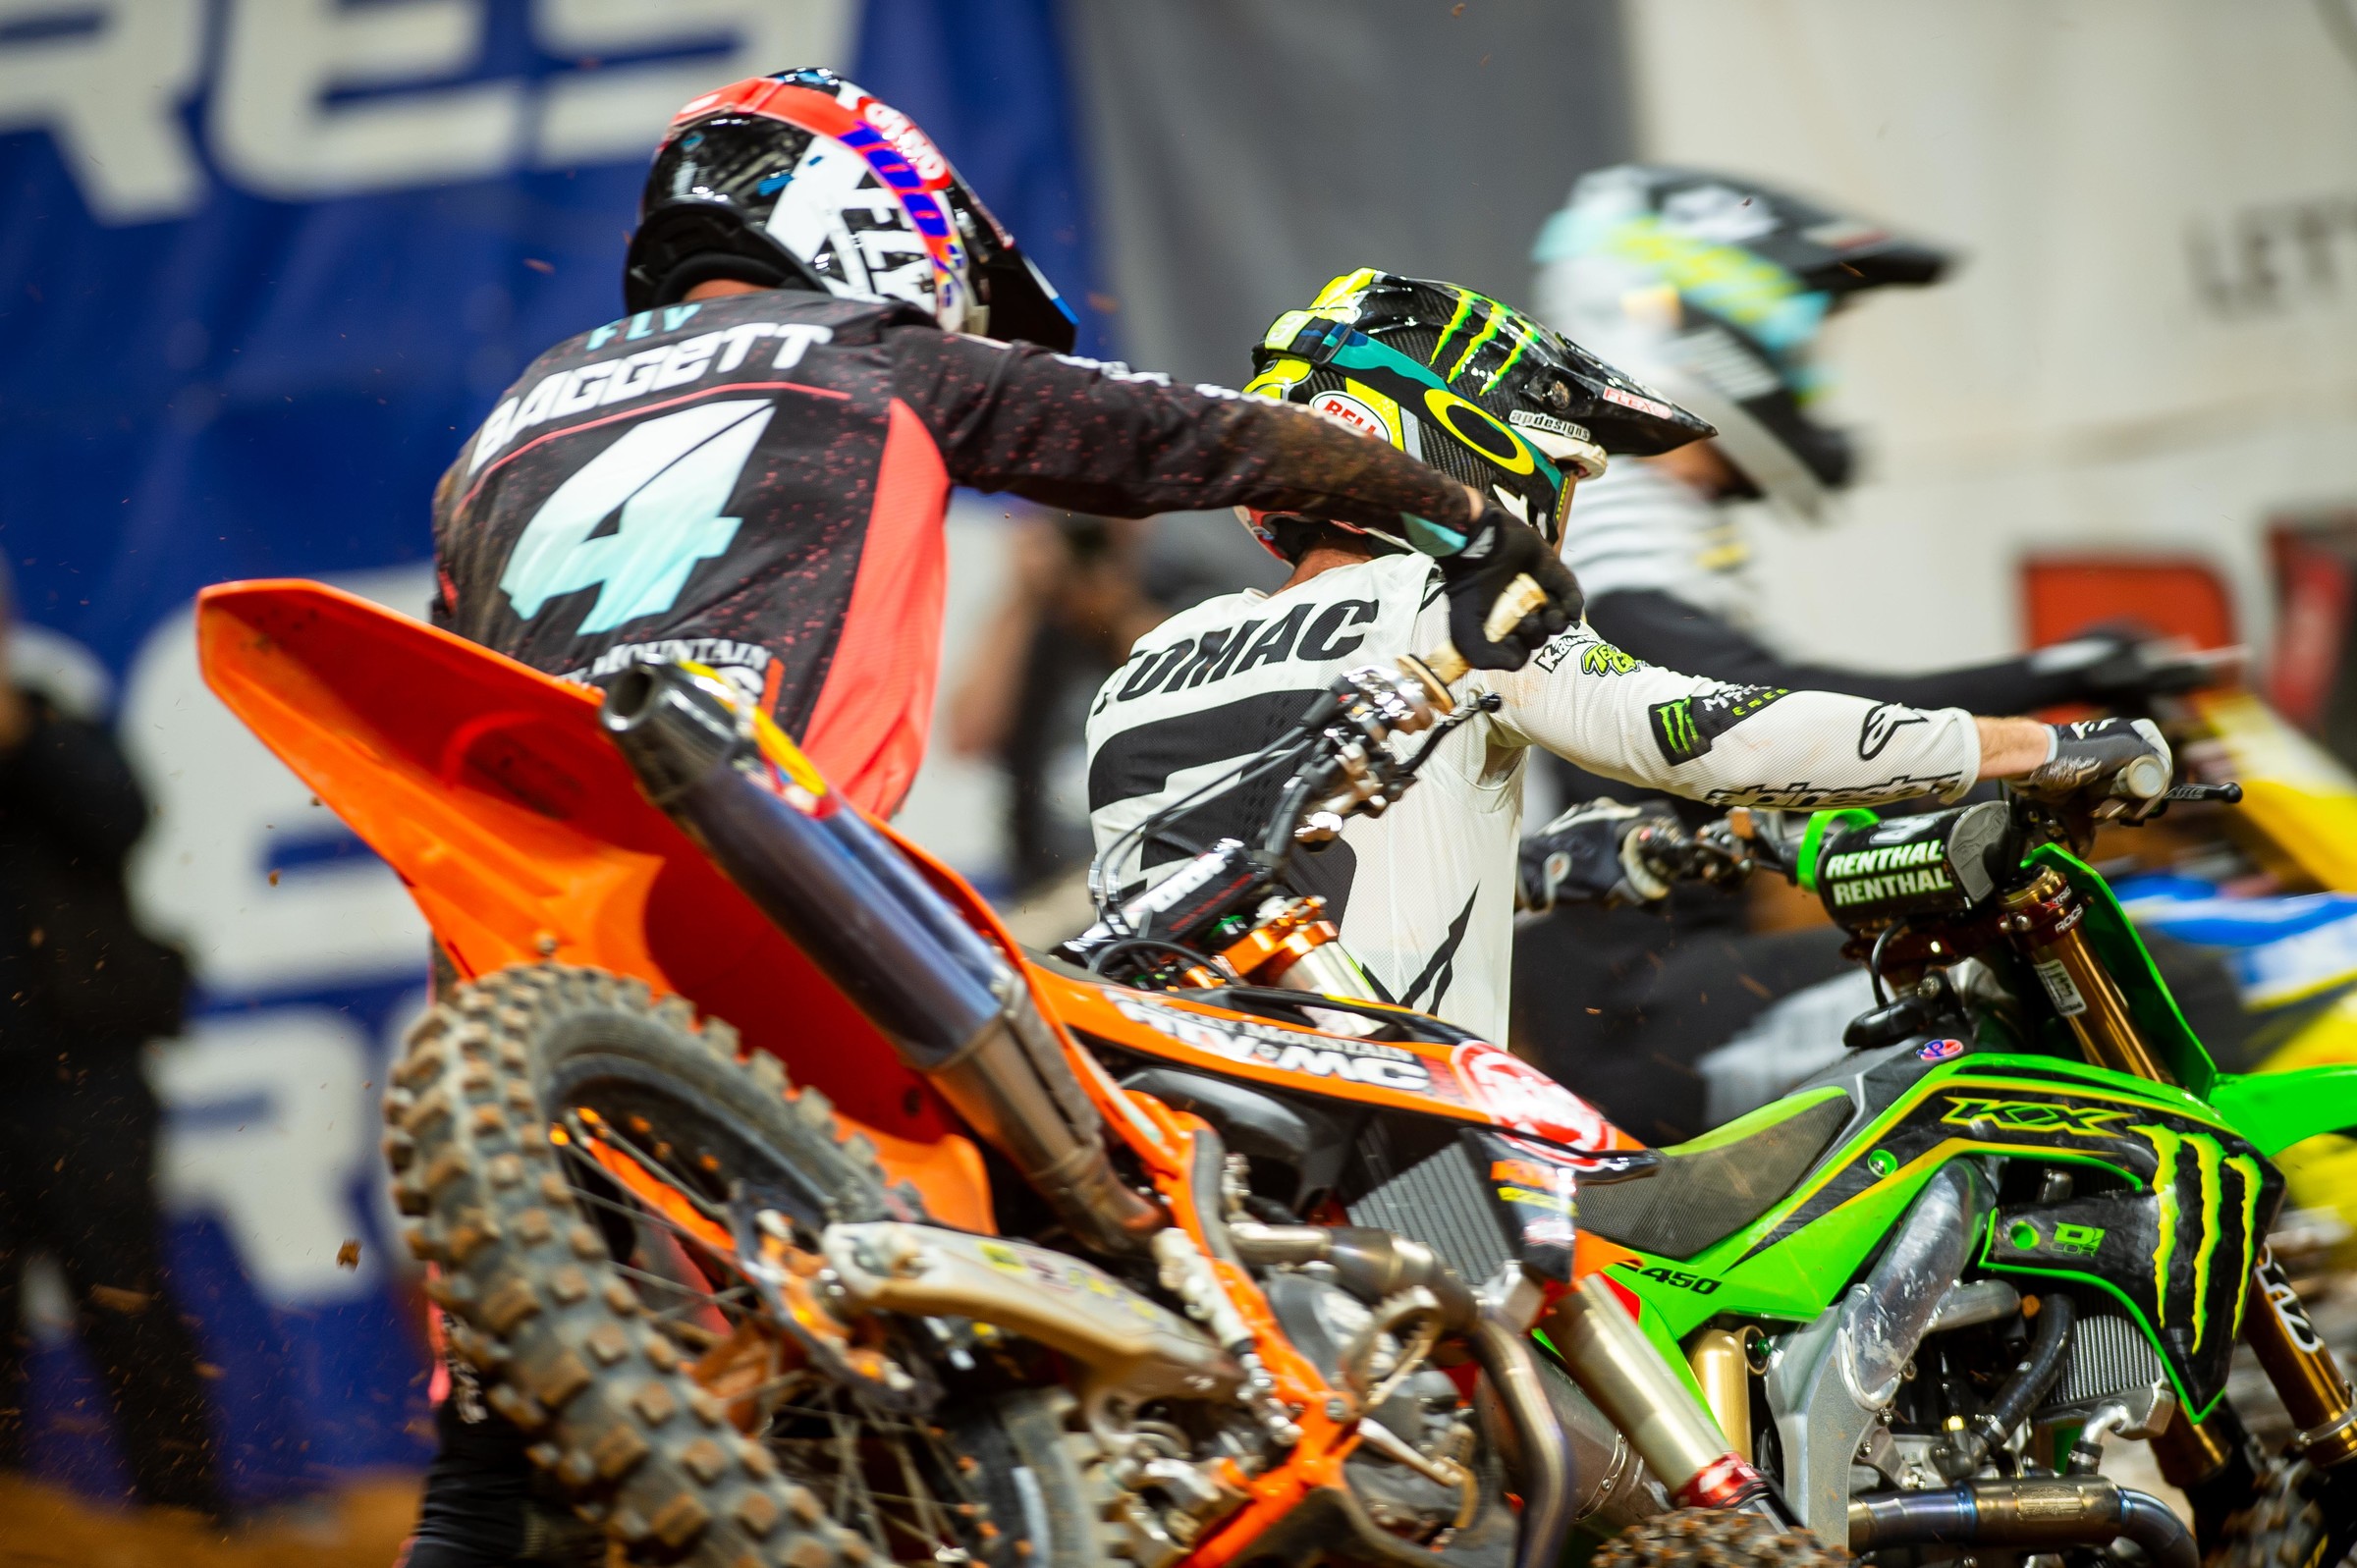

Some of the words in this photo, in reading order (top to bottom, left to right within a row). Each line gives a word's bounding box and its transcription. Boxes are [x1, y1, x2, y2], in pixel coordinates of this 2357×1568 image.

[587, 303, 702, 351] FLY
[467, 322, 834, 477] BAGGETT
[1509, 410, 1590, 441] apdesigns
[499, 399, 778, 636] 4
[1825, 839, 1943, 880] RENTHAL
[1832, 867, 1953, 907] RENTHAL
[2041, 885, 2072, 912] XTRIG
[2055, 903, 2084, 934] ROCS
[1941, 1097, 2138, 1139] KX
[1639, 1268, 1723, 1295] 450
